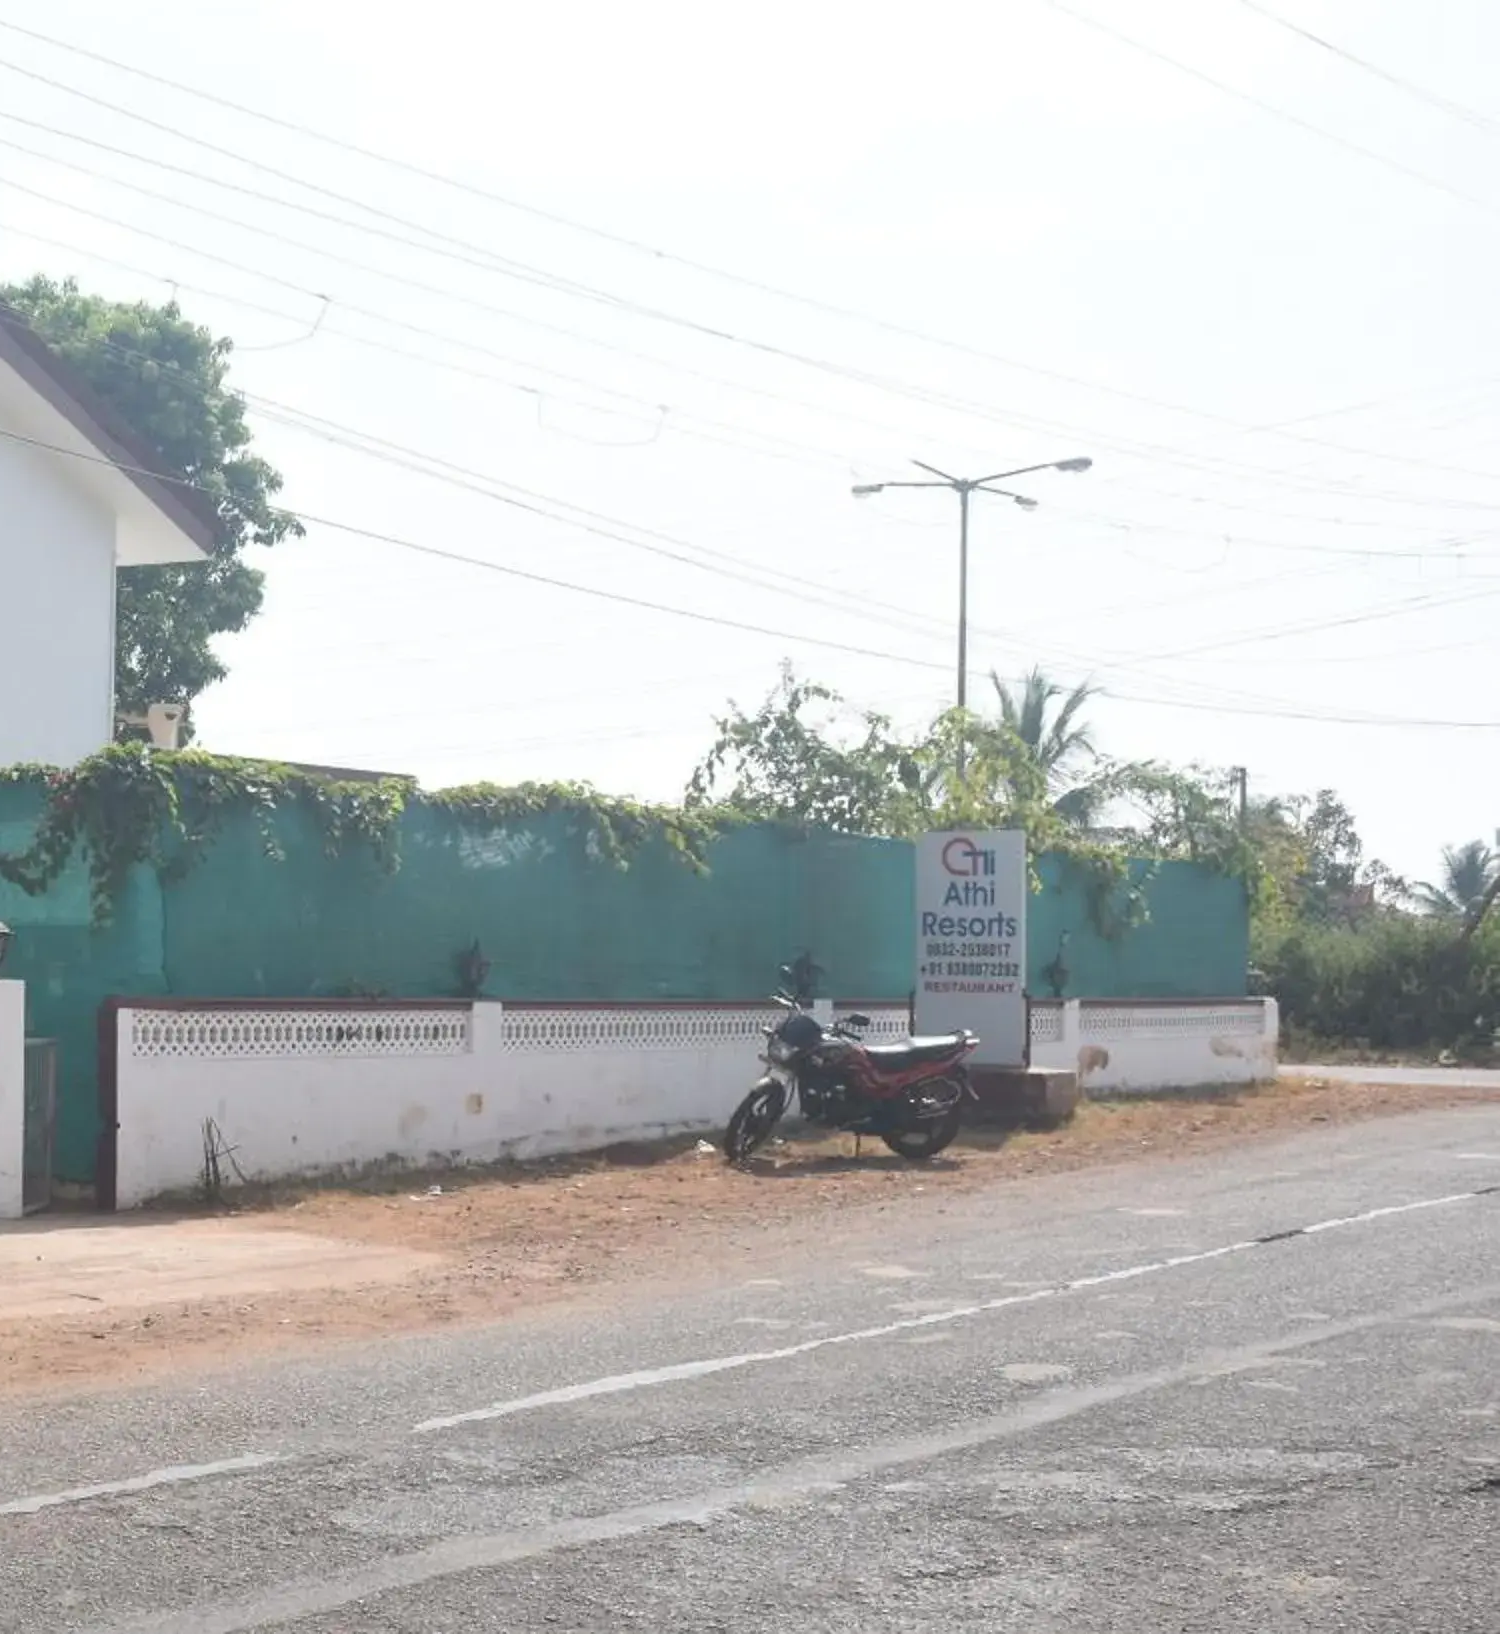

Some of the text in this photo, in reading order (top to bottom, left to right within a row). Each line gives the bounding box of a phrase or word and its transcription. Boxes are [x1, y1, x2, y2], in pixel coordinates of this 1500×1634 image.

[943, 880, 995, 906] Athi
[922, 911, 1017, 937] Resorts
[924, 981, 1015, 993] RESTAURANT
